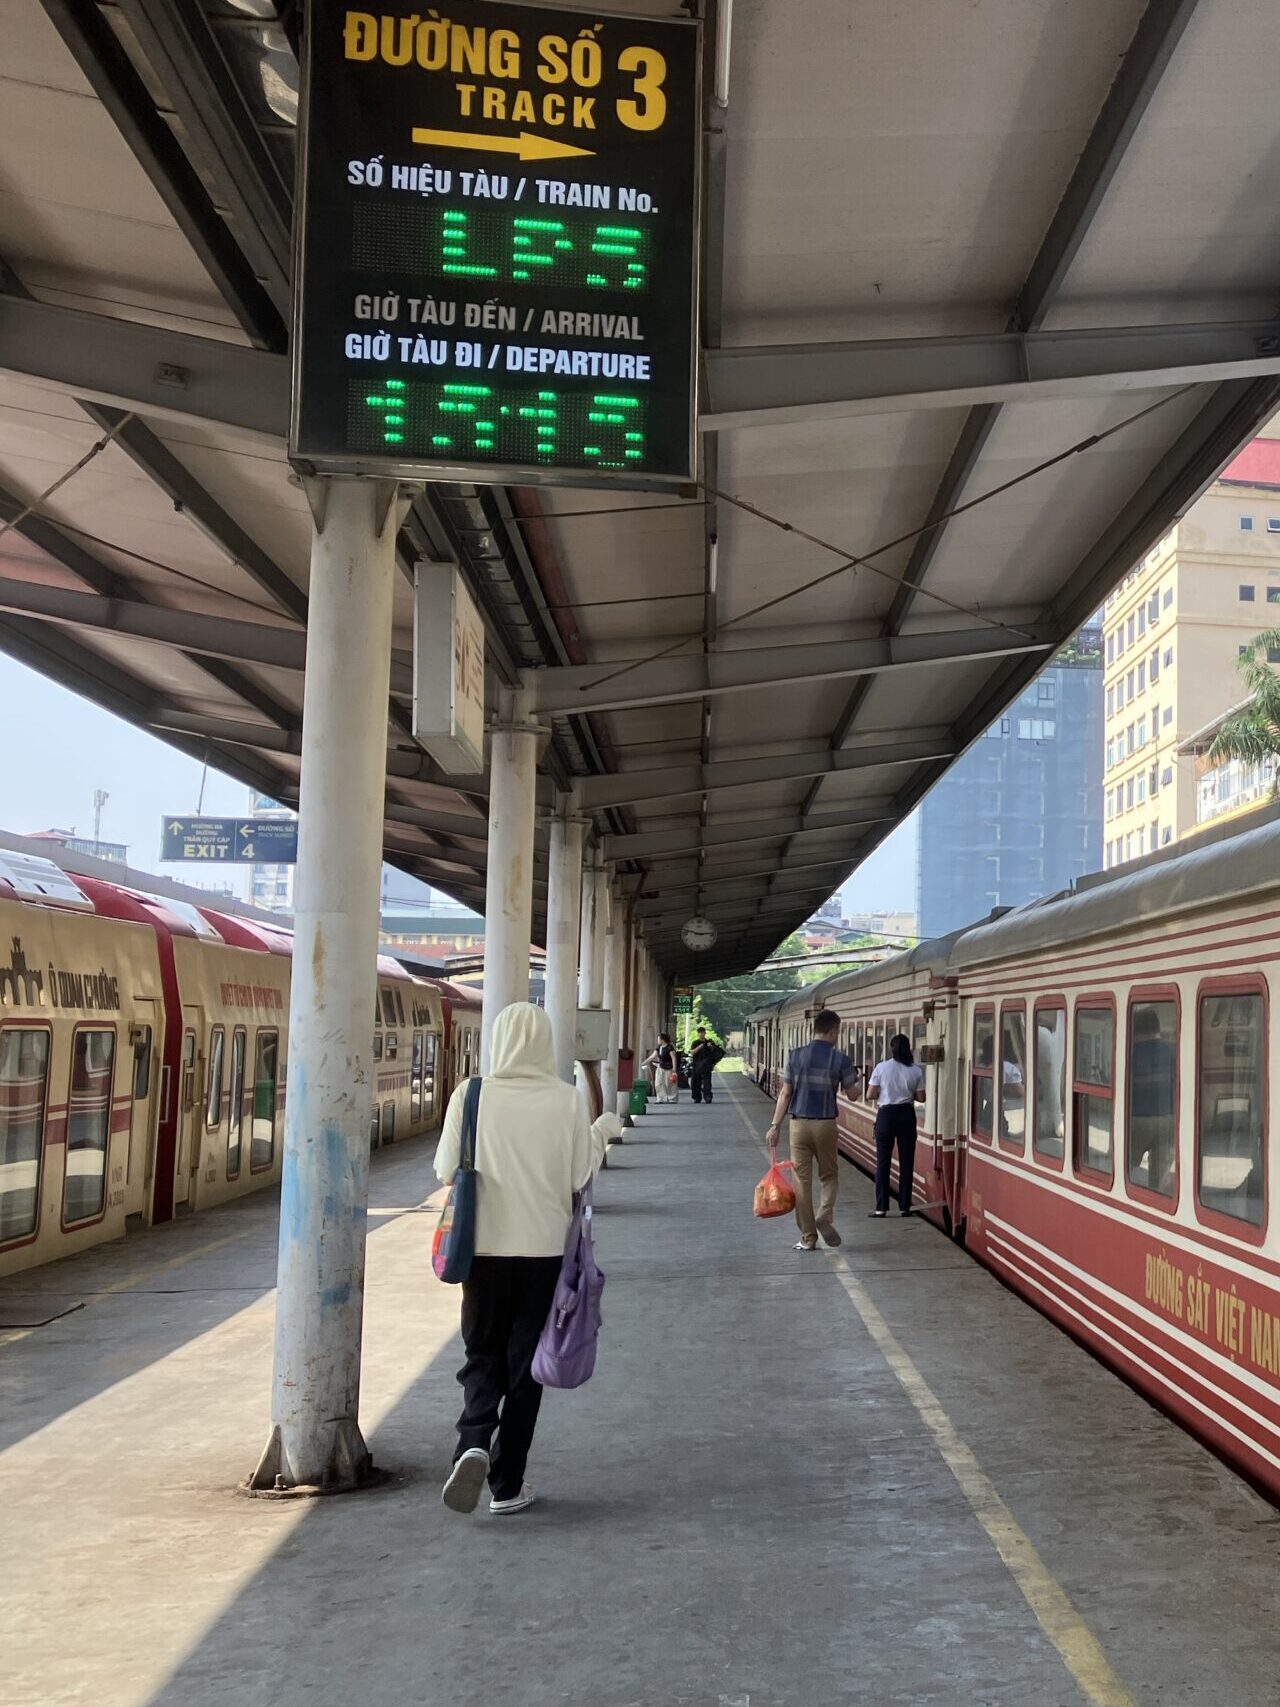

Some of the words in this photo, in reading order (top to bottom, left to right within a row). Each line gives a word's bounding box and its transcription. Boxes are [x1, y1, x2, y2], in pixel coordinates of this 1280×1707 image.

[343, 9, 520, 78] ĐƯỜNG
[537, 24, 603, 88] SỐ
[617, 46, 667, 131] 3
[456, 83, 597, 129] TRACK
[347, 155, 384, 187] SỐ
[391, 163, 451, 198] HIỆU
[459, 168, 509, 200] TÀU
[514, 178, 528, 201] /
[535, 179, 611, 209] TRAIN
[618, 190, 659, 213] No.
[354, 290, 400, 322] GIỜ
[407, 297, 457, 327] TÀU
[464, 297, 517, 332] ĐẾN
[523, 308, 535, 332] /
[540, 309, 645, 340] ARRIVAL
[344, 329, 391, 361] GIỜ
[398, 333, 449, 365] TÀU
[455, 341, 482, 368] ĐI
[487, 344, 501, 370] /
[506, 345, 652, 380] DEPARTURE
[183, 843, 229, 858] EXIT
[241, 843, 256, 859] 4
[257, 824, 284, 833] ĐƯỜNG
[1146, 1249, 1184, 1320] ĐƯỜNG
[1215, 1284, 1246, 1364] VIỆT
